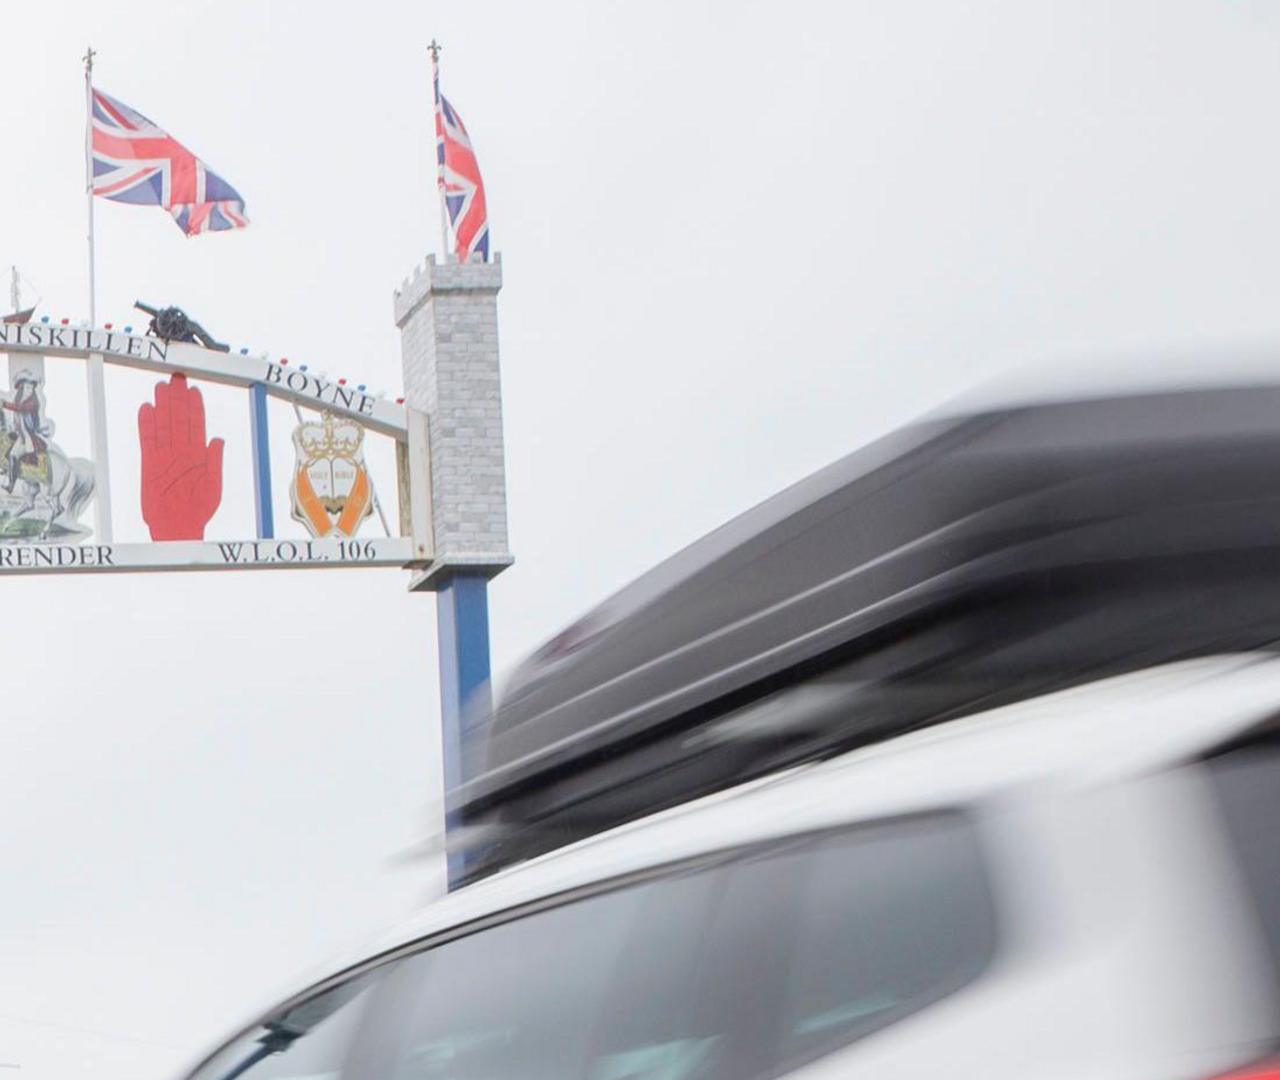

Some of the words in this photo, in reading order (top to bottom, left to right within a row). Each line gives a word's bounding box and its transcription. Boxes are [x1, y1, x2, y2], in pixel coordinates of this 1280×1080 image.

[265, 362, 376, 418] BOYNE
[218, 542, 329, 563] W.L.O.L.
[339, 540, 376, 560] 106
